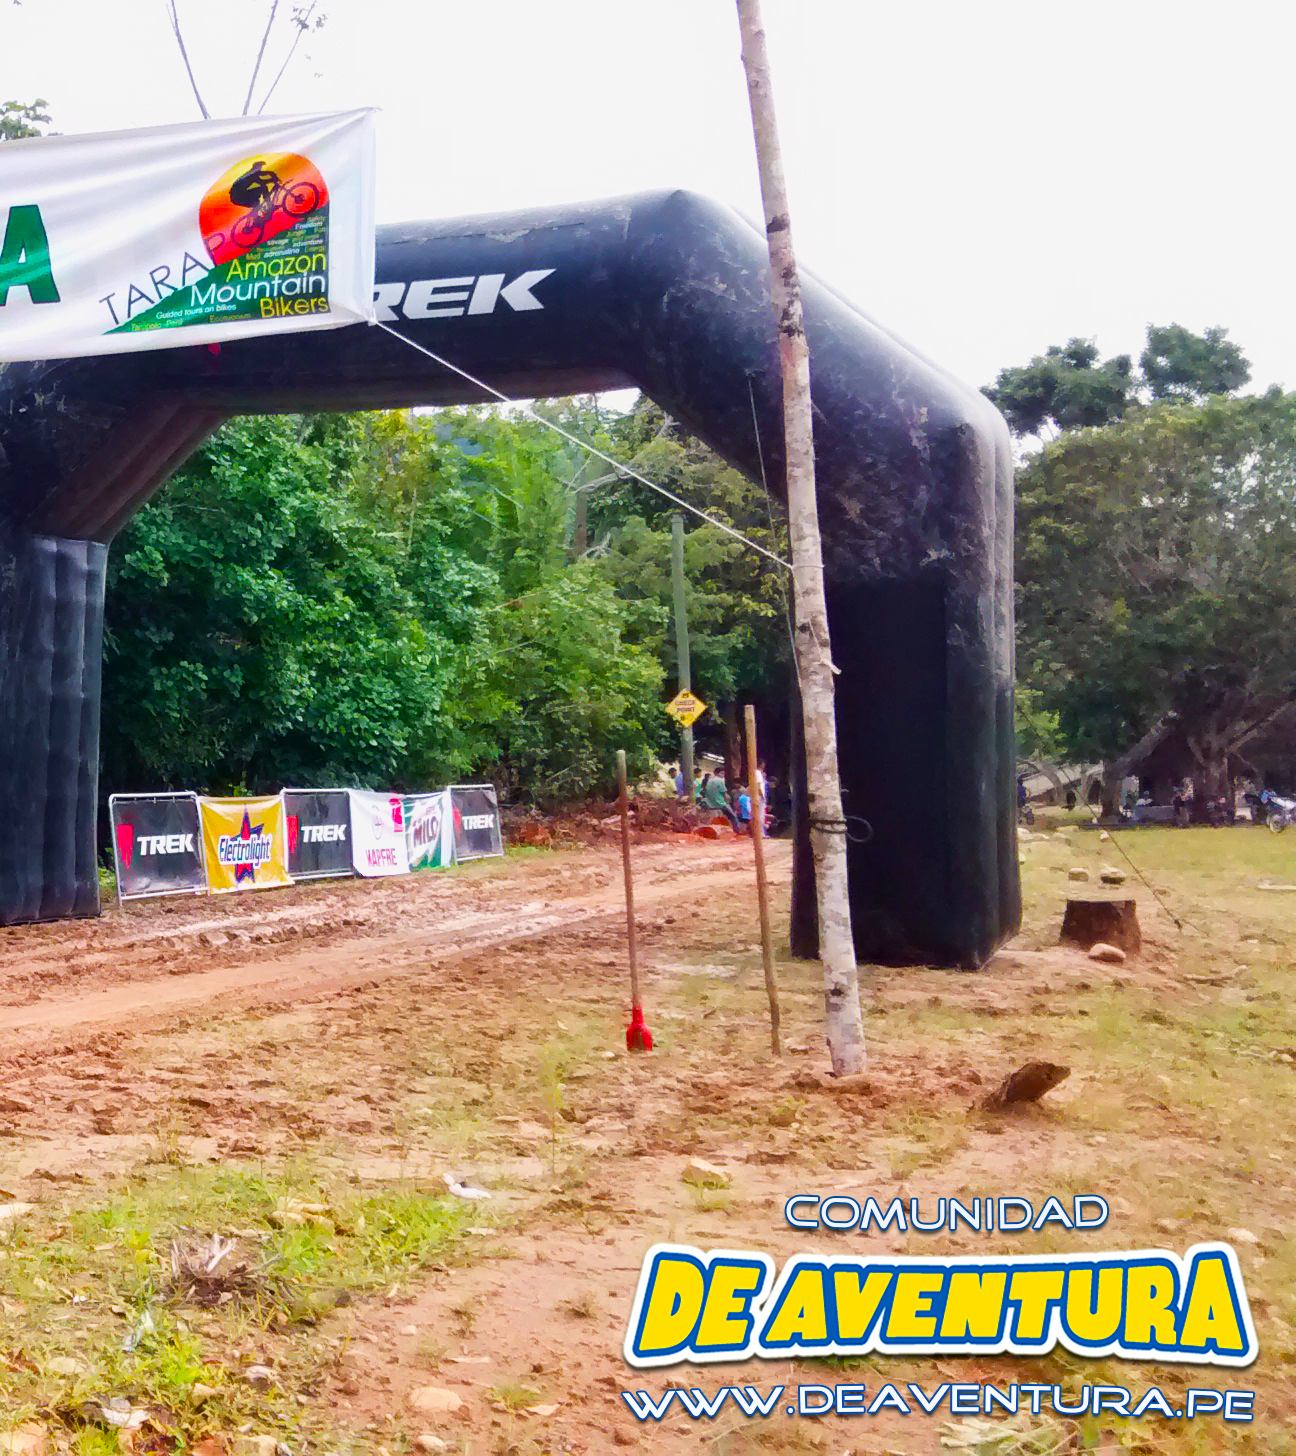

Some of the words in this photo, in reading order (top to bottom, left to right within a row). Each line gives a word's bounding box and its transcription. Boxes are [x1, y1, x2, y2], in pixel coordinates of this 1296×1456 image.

[226, 252, 326, 283] Amazon
[190, 271, 326, 306] Mountain
[373, 268, 556, 321] REK
[156, 310, 183, 319] Guided
[184, 308, 202, 316] tours
[216, 304, 237, 312] bikes
[260, 296, 328, 319] Bikers
[301, 824, 347, 843] TREK
[413, 815, 439, 848] MILO
[462, 814, 494, 831] TREK
[137, 833, 194, 856] TREK
[219, 834, 272, 866] Electrolight
